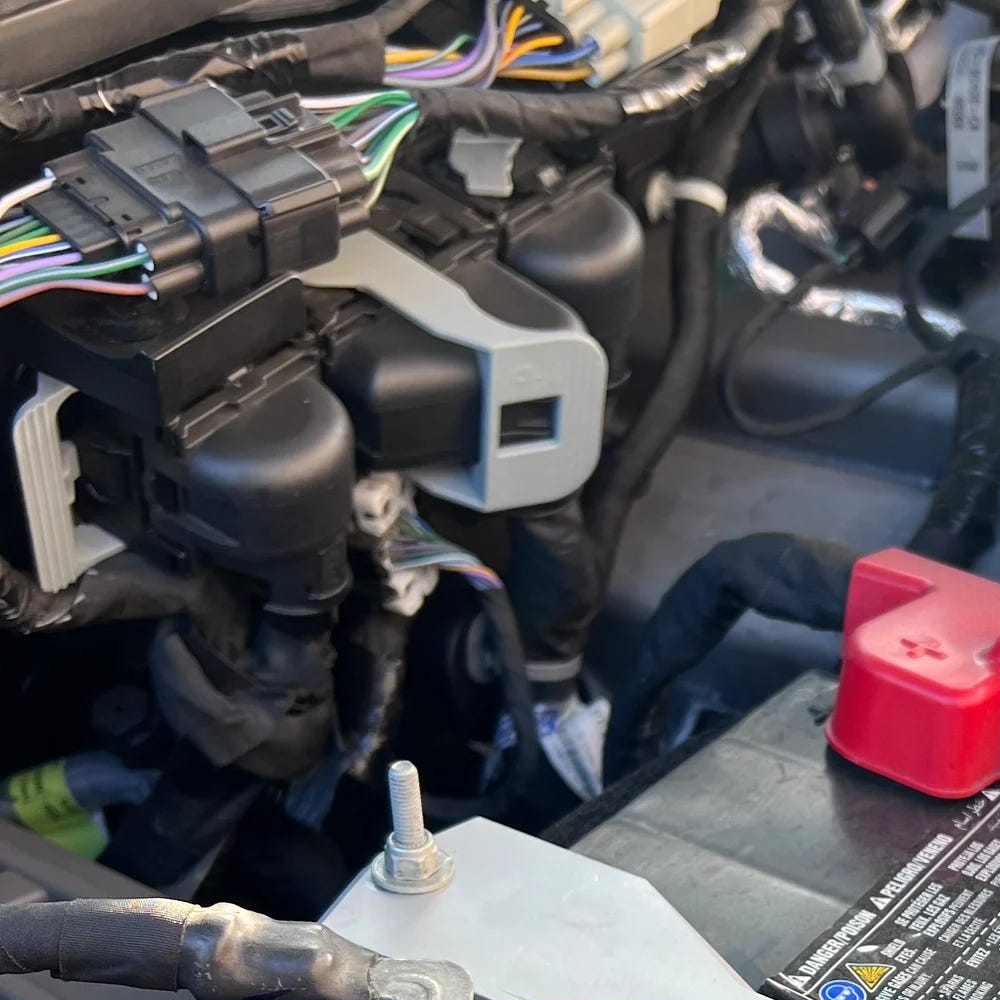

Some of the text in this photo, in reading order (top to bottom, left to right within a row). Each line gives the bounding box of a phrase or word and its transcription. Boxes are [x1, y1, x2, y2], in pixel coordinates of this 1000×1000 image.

[880, 834, 952, 898] PELIGRO/VENENO
[799, 910, 876, 975] DANGER/POISON
[887, 971, 912, 989] GASES
[904, 962, 922, 975] CAN
[914, 947, 937, 965] CAUSE
[962, 947, 991, 968] ÉVITEZ
[901, 987, 916, 998] OR
[939, 974, 964, 996] SPARKS
[952, 978, 978, 1000] FLAMES
